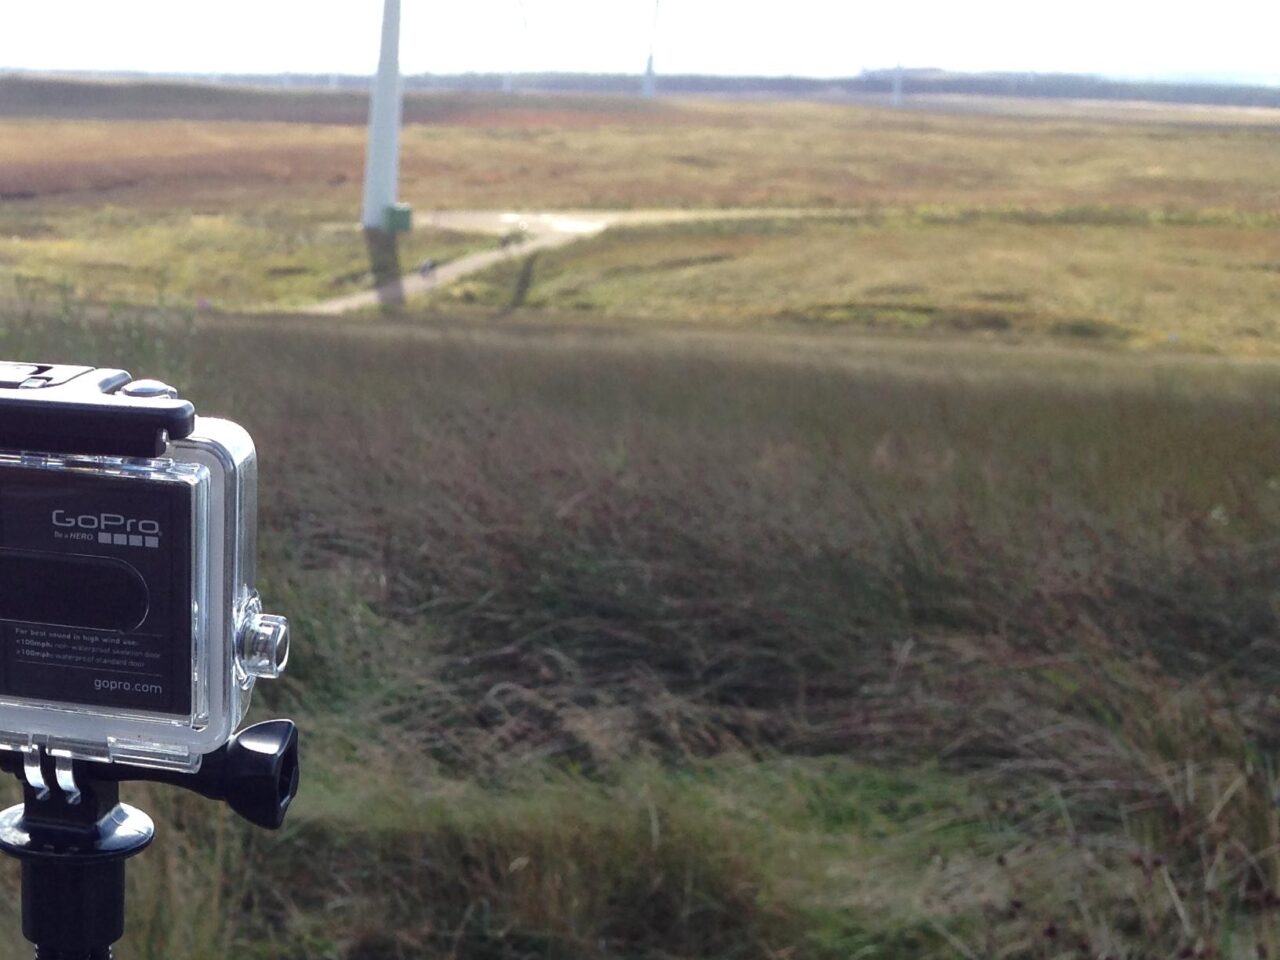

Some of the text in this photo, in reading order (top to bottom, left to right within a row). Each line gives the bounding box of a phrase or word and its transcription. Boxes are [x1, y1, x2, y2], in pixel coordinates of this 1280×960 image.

[52, 510, 159, 533] GoPro
[70, 532, 93, 541] HERO
[94, 678, 162, 694] gopro.com
